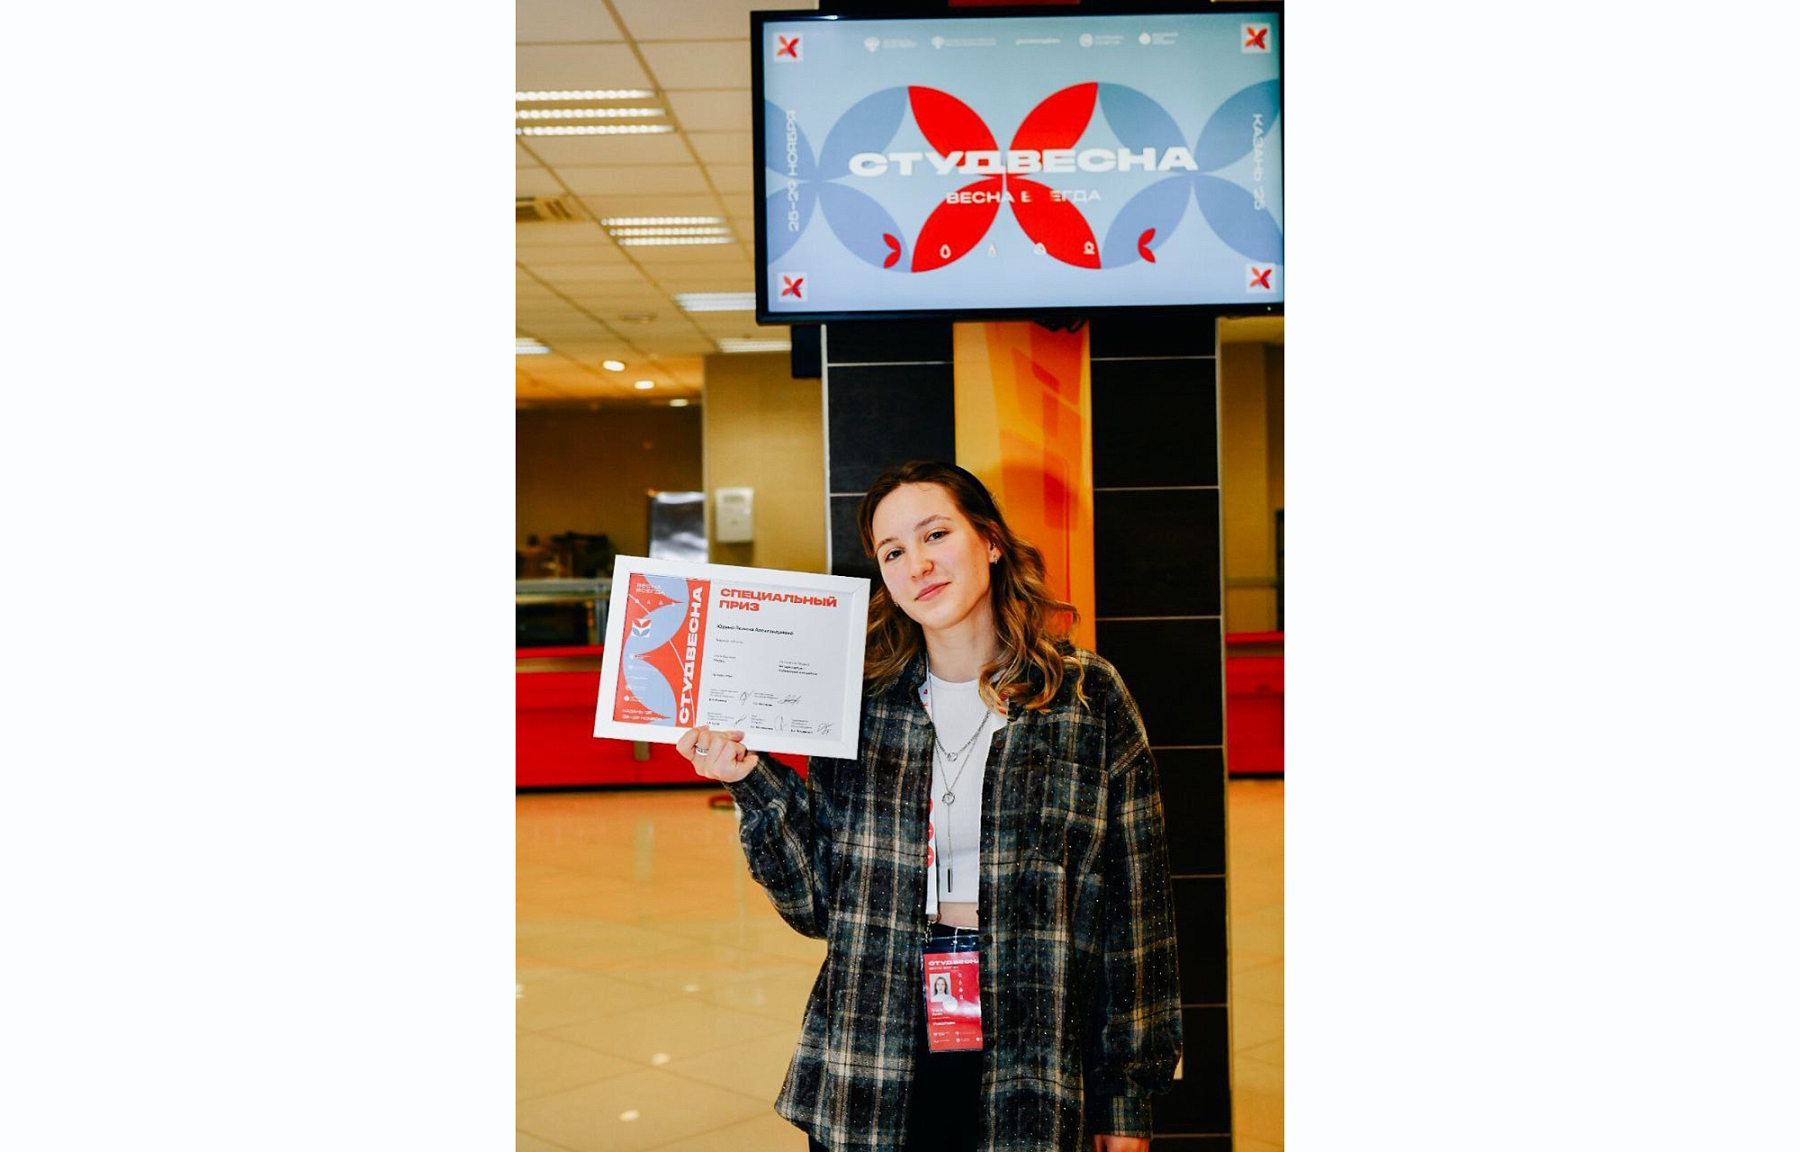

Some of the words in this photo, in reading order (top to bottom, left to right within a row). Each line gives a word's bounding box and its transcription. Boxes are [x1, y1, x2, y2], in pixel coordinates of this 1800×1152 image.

[785, 109, 798, 177] НОЯБРЯ
[1252, 113, 1264, 182] КАЗАНЬ
[848, 146, 1199, 177] СТУДВЕСНА
[946, 191, 1015, 204] ВЕСНА
[1021, 189, 1101, 203] ВЕГДА
[719, 600, 760, 612] ПРИЗ
[720, 588, 838, 607] СПЕЦИАЛЬНЫЙ
[679, 586, 703, 724] СТУДВЕСНА
